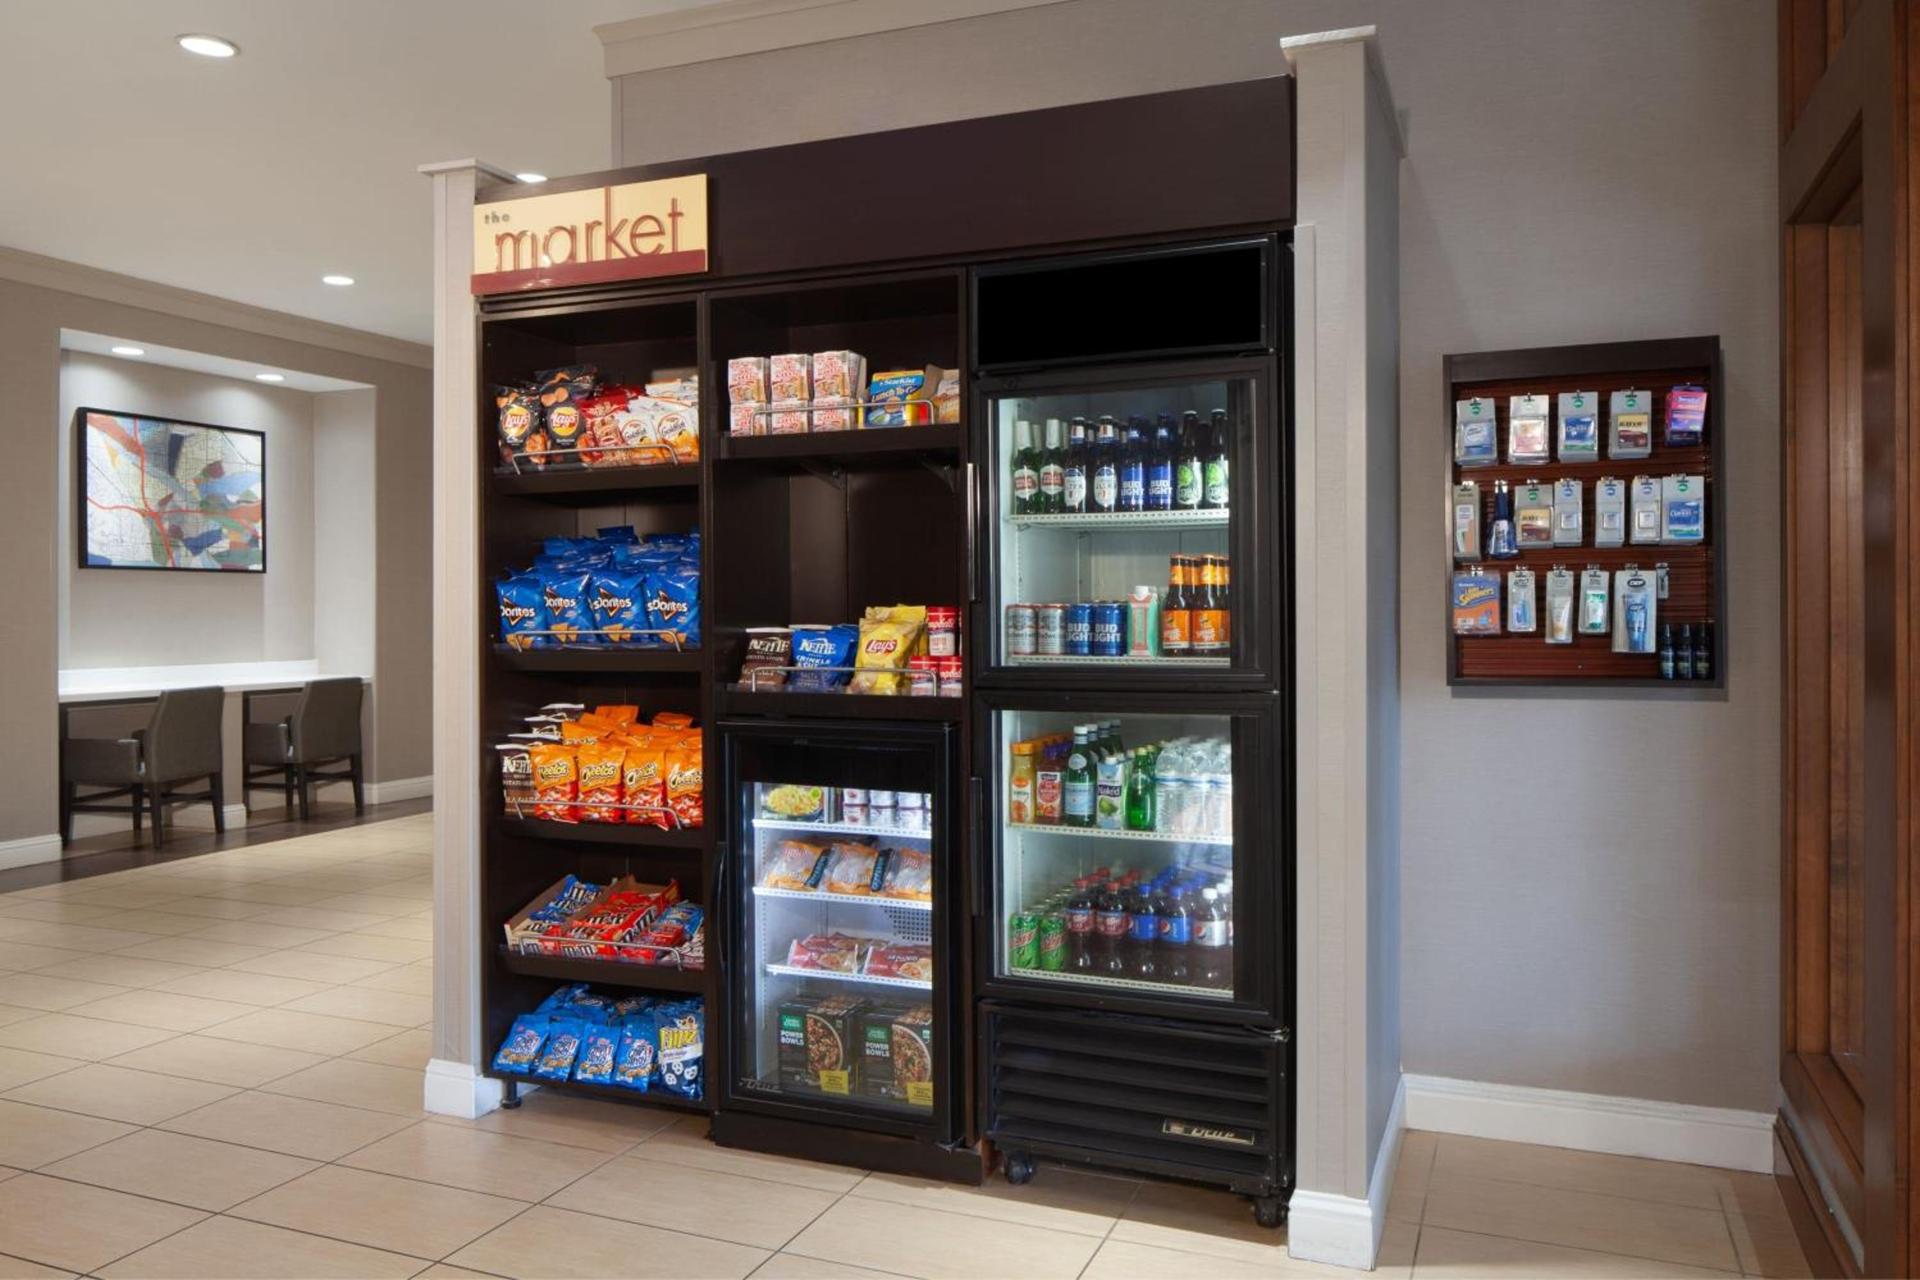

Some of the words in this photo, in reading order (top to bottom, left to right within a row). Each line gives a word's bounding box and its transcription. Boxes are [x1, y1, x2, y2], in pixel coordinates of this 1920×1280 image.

[484, 211, 510, 224] the
[495, 186, 684, 273] market
[866, 639, 897, 653] Lay's
